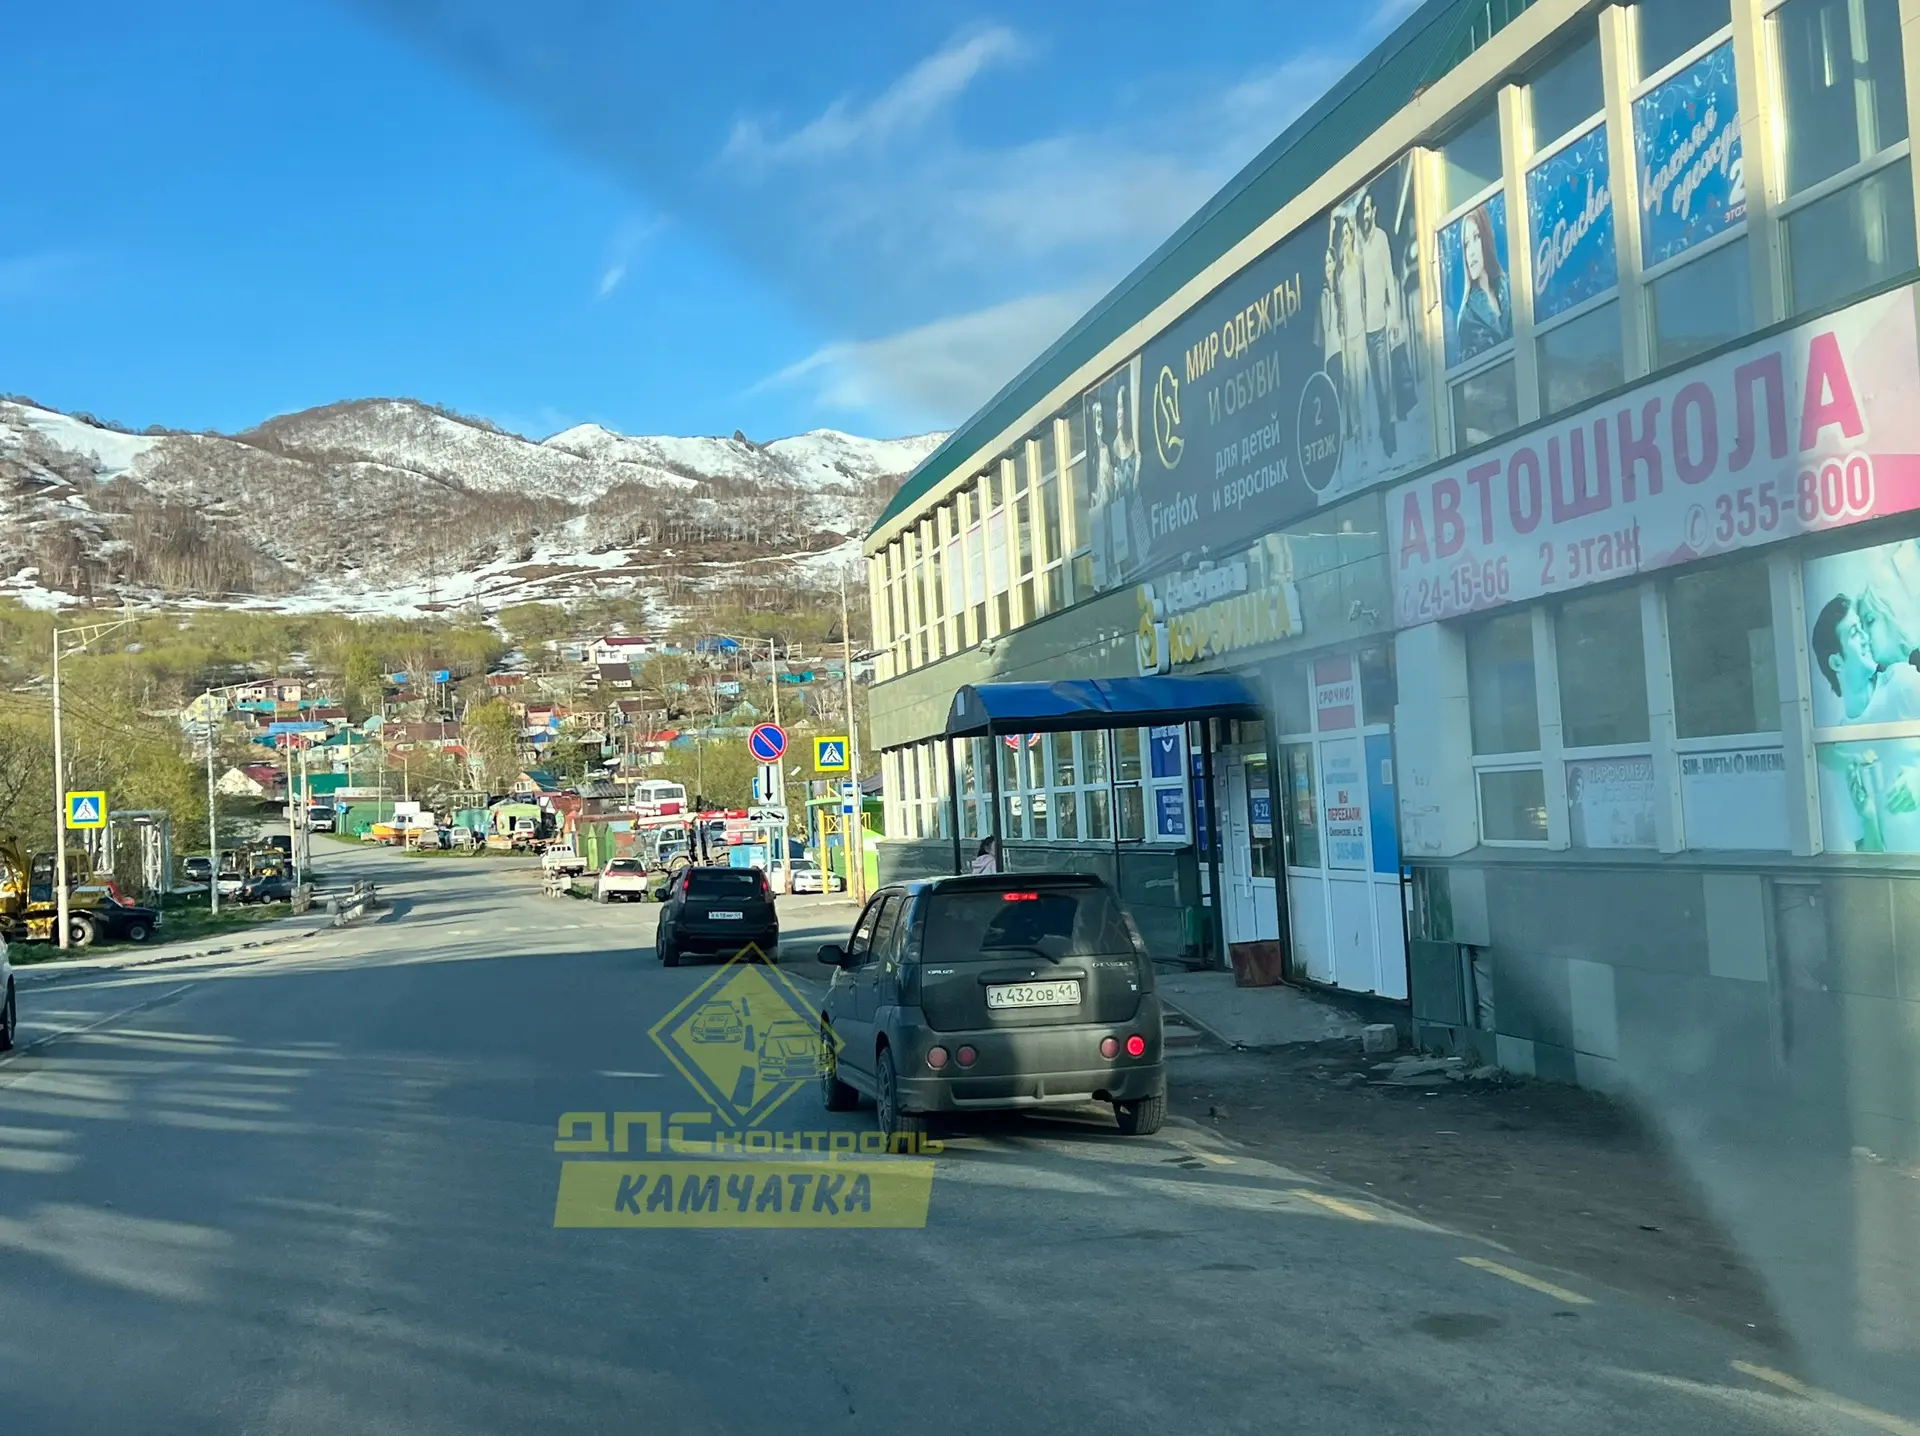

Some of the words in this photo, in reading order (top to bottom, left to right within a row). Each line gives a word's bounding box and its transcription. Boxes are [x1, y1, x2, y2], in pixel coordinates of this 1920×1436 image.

[1728, 157, 1745, 206] 2
[1535, 176, 1612, 296] Женска
[1185, 331, 1220, 385] МИР
[1222, 272, 1302, 361] ОДЕЖДЫ
[1208, 386, 1222, 426] И
[1223, 350, 1281, 417] ОБУВИ
[1313, 395, 1323, 427] 2
[1215, 442, 1239, 479] для
[1241, 411, 1281, 467] детей
[1304, 432, 1337, 466] этаж
[1400, 331, 1865, 571] АВТОШКОЛА
[1150, 491, 1200, 540] Firefox
[1212, 488, 1222, 513] и
[1223, 456, 1290, 511] взрослых
[1418, 554, 1511, 615] 24-15-66
[1538, 541, 1556, 586] 2
[1566, 524, 1641, 580] этаж
[1715, 456, 1870, 544] 355-800
